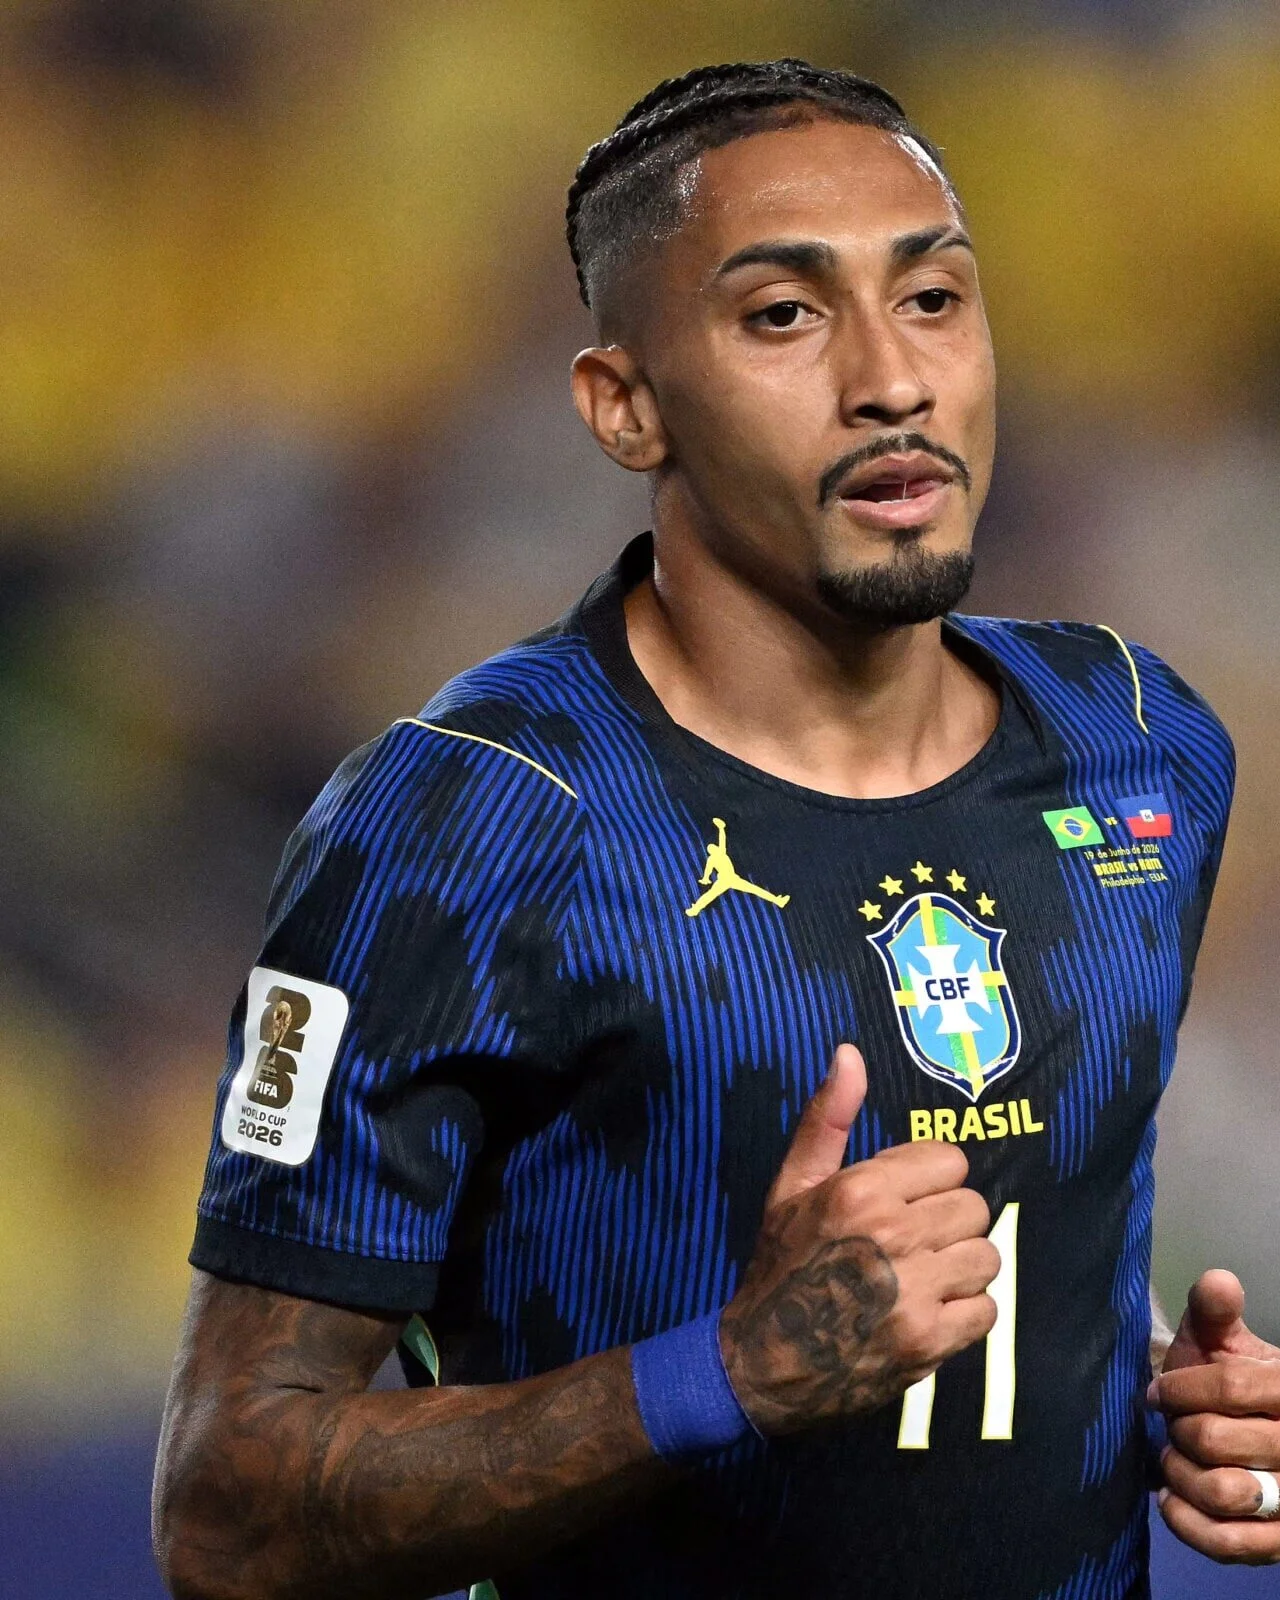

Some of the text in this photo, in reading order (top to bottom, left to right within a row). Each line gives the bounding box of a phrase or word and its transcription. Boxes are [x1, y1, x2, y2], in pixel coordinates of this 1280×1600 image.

[1104, 817, 1118, 826] vs
[1084, 843, 1160, 860] 19 de Junho de 2026
[1127, 862, 1139, 872] vs
[1100, 874, 1146, 888] Philadelphia
[1148, 872, 1168, 883] EUA
[925, 977, 971, 1001] CBF
[254, 1080, 278, 1098] FIFA
[241, 1104, 287, 1127] WORLD CUP
[909, 1099, 1044, 1144] BRASIL
[237, 1118, 283, 1147] 2026
